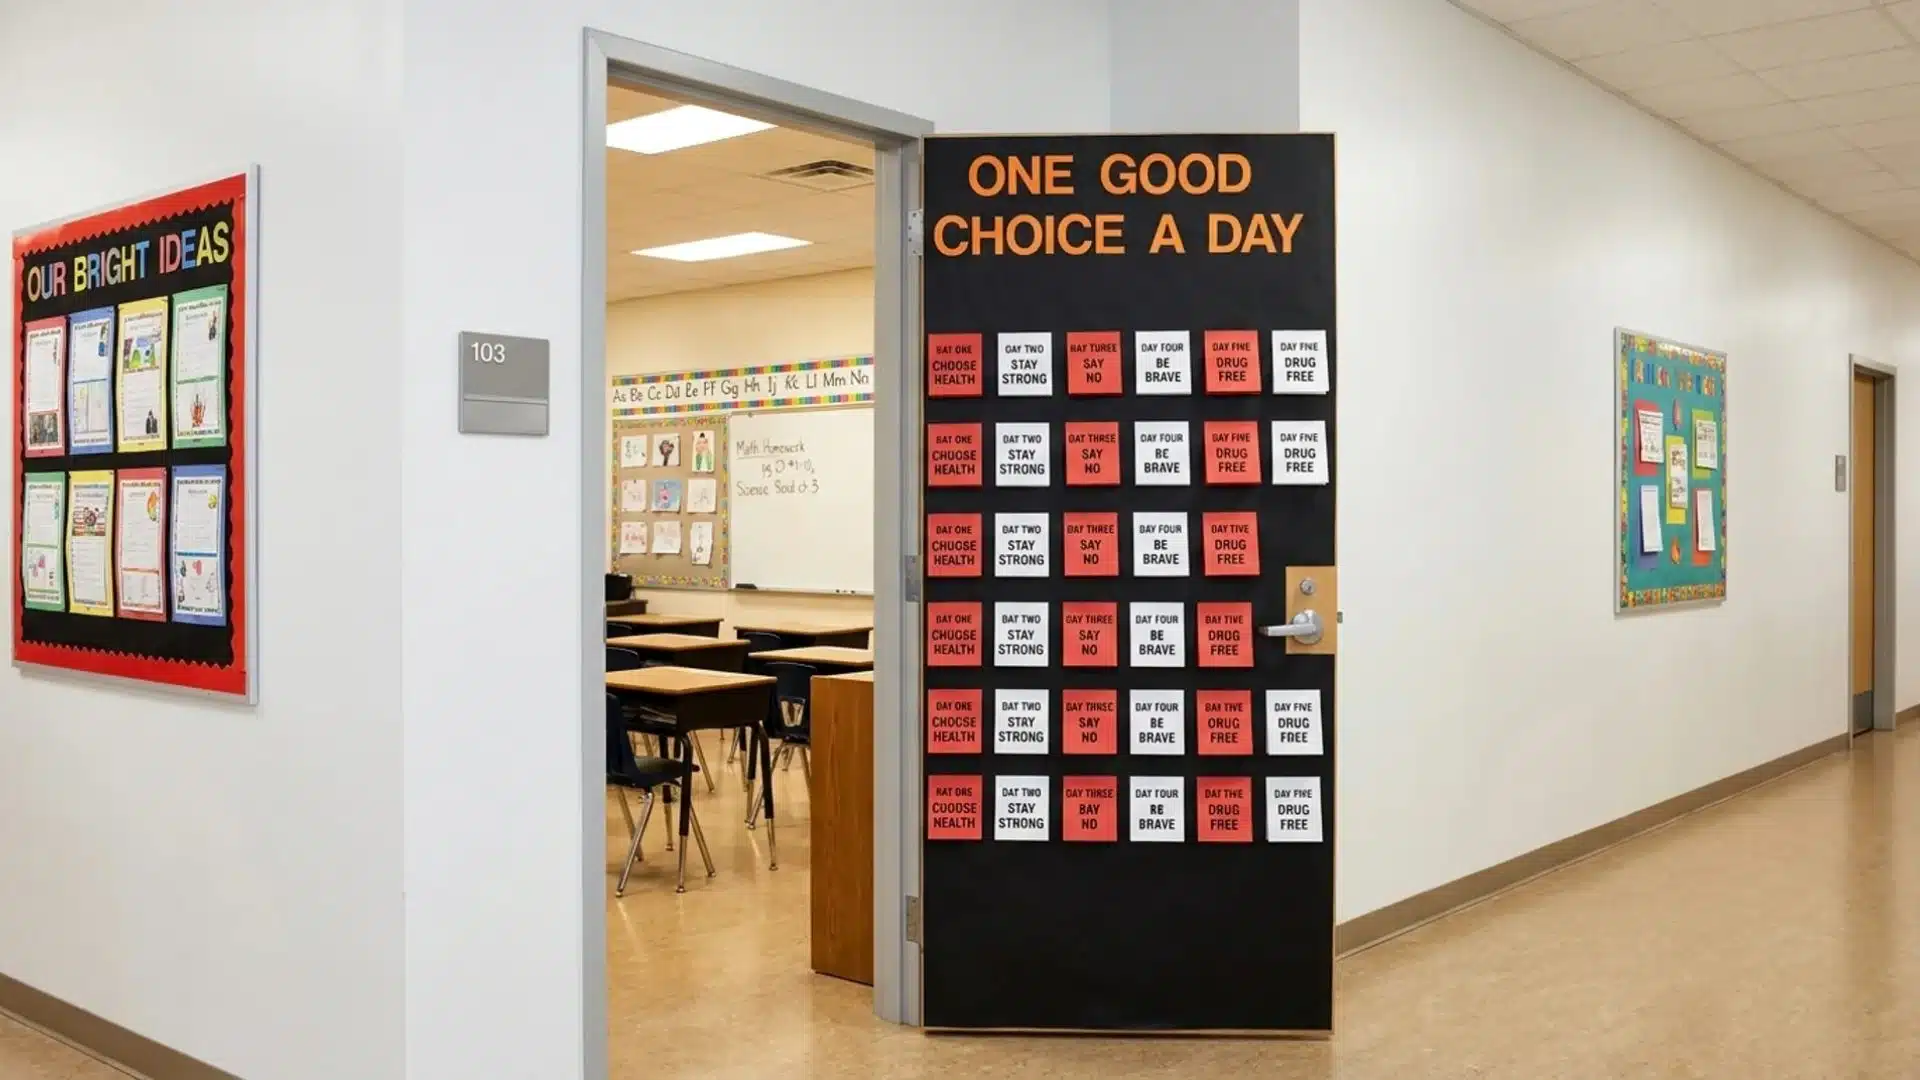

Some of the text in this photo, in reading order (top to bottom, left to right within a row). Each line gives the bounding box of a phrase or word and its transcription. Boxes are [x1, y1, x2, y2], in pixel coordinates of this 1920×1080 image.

[968, 152, 1252, 197] ONE GOOD
[933, 213, 1304, 257] CHOICE A DAY
[27, 220, 230, 302] OUR BRIGHT IDEAS
[1024, 344, 1044, 354] TWO
[1141, 343, 1184, 352] DAY FOUR
[1280, 342, 1297, 351] DAY
[471, 342, 506, 364] 103
[1011, 359, 1038, 370] STAY
[1083, 358, 1104, 369] SAY
[1156, 357, 1170, 369] BE
[1216, 357, 1248, 368] DRUG
[1285, 357, 1316, 368] DRUG
[934, 374, 975, 385] HEALTH
[1002, 373, 1047, 384] STRONG
[1086, 372, 1102, 383] NO
[1145, 371, 1181, 382] BRAVE
[1218, 370, 1246, 382] FREE
[1286, 370, 1314, 382] FREE
[647, 385, 662, 401] Cc
[721, 379, 739, 399] Gg
[823, 372, 847, 387] Mm
[1022, 434, 1042, 444] TWO
[1160, 433, 1183, 443] FOUR
[1280, 433, 1297, 442] DAY
[1008, 449, 1036, 460] STAY
[1082, 448, 1103, 460] SAY
[1155, 448, 1169, 459] BE
[1216, 447, 1248, 459] DRUG
[1284, 448, 1316, 459] DRUG
[934, 464, 975, 475] HEALTH
[1000, 463, 1045, 475] STRONG
[1144, 462, 1180, 473] BRAVE
[1218, 461, 1246, 472] FREE
[1286, 461, 1314, 473] FREE
[1021, 525, 1041, 534] TWO
[1158, 524, 1182, 534] FOUR
[1008, 540, 1035, 551] STAY
[1080, 539, 1102, 551] SAY
[1154, 539, 1168, 550] BE
[1215, 539, 1247, 550] DRUG
[934, 554, 975, 566] HEALTH
[999, 554, 1044, 565] STRONG
[1083, 553, 1099, 565] NO
[1143, 553, 1179, 565] BRAVE
[1217, 553, 1244, 564] FREE
[1021, 614, 1041, 624] TWO
[1155, 615, 1179, 624] FOUR
[1008, 629, 1034, 640] STAY
[1079, 630, 1100, 641] SAY
[1150, 630, 1164, 641] BE
[934, 643, 975, 655] HEALTH
[998, 644, 1044, 655] STRONG
[1081, 644, 1098, 656] NO
[1139, 644, 1175, 655] BRAVE
[1210, 644, 1238, 656] FREE
[1008, 717, 1035, 728] STAY
[1079, 717, 1100, 728] SAY
[1150, 717, 1164, 728] BE
[1278, 717, 1310, 729] DRUG
[933, 731, 975, 742] HEALTH
[998, 731, 1044, 743] STRONG
[1081, 731, 1098, 743] NO
[1139, 732, 1175, 743] BRAVE
[1008, 802, 1036, 814] STAY
[1278, 804, 1310, 815] DRUG
[998, 817, 1044, 829] STRONG
[1139, 818, 1175, 830] BRAVE
[1280, 819, 1308, 830] FREE
